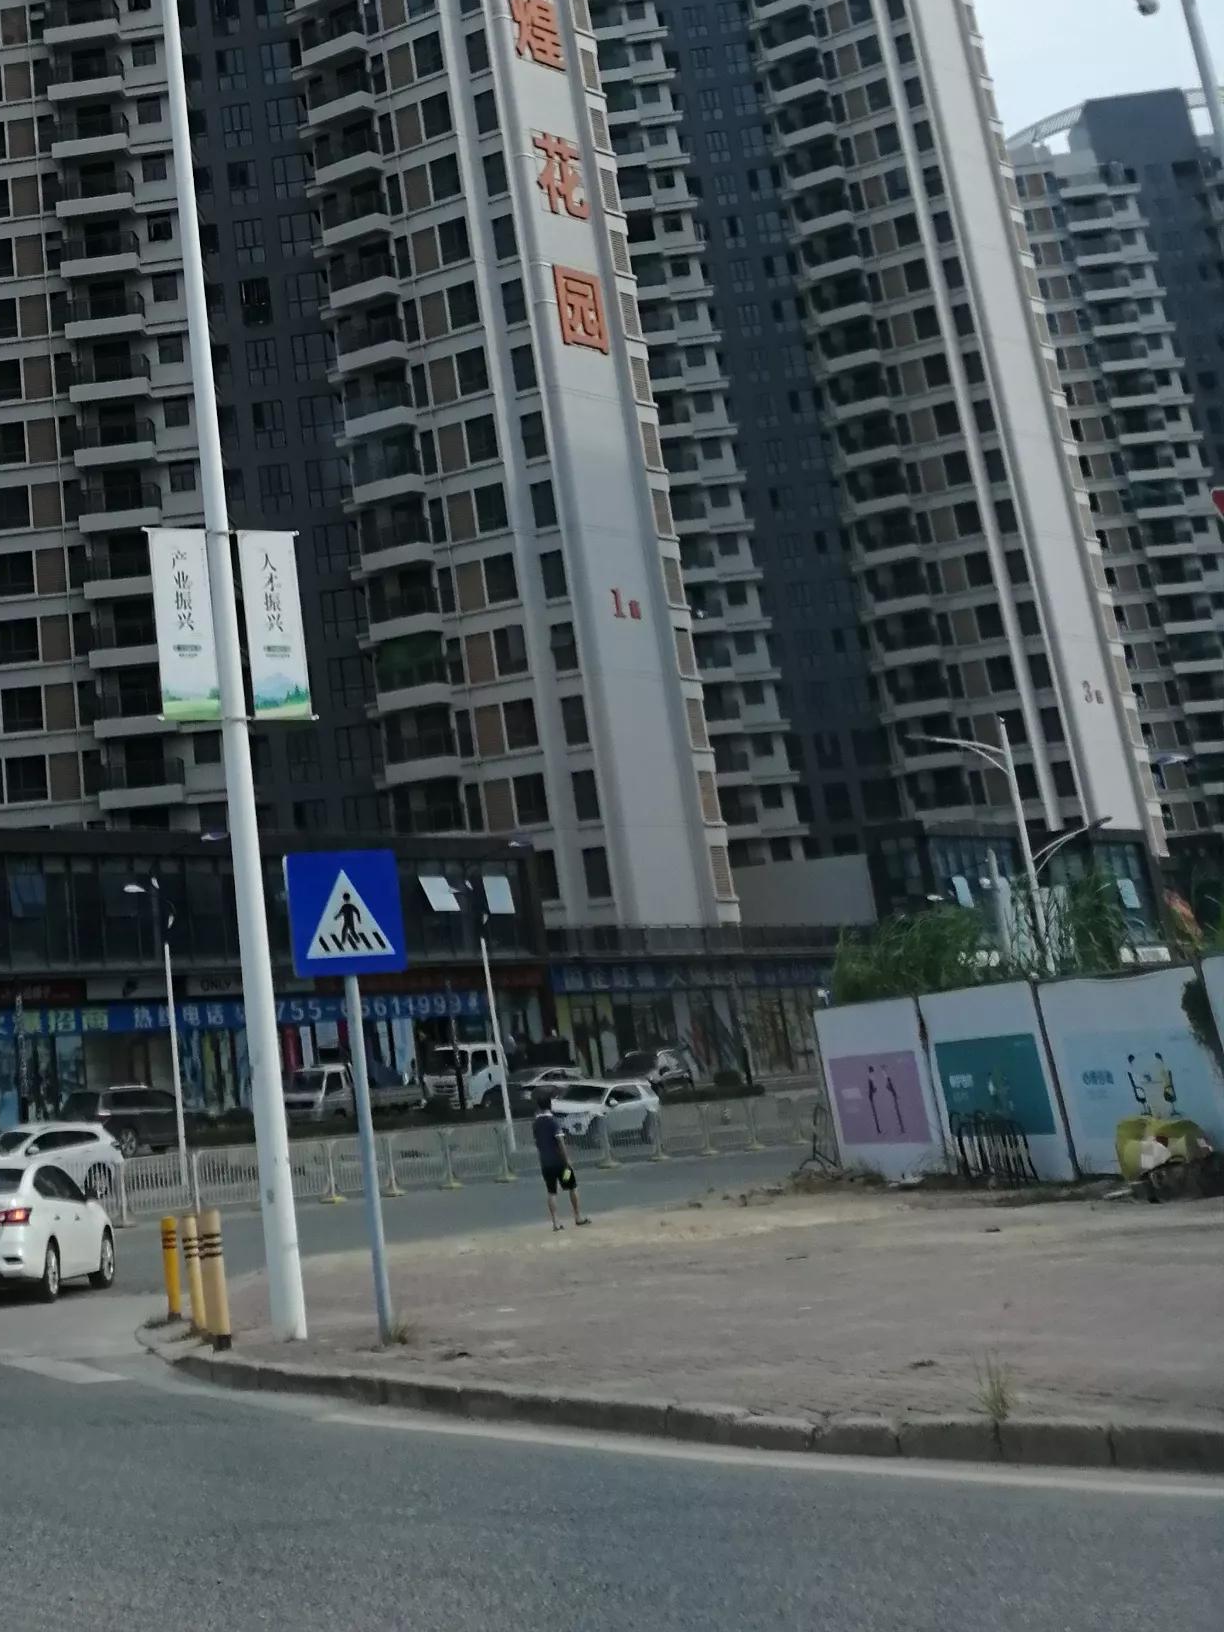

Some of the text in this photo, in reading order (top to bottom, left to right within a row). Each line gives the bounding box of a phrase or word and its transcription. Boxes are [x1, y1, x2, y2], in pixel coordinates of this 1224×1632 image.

[171, 550, 195, 631] 产业振兴
[261, 553, 285, 633] 人才振兴
